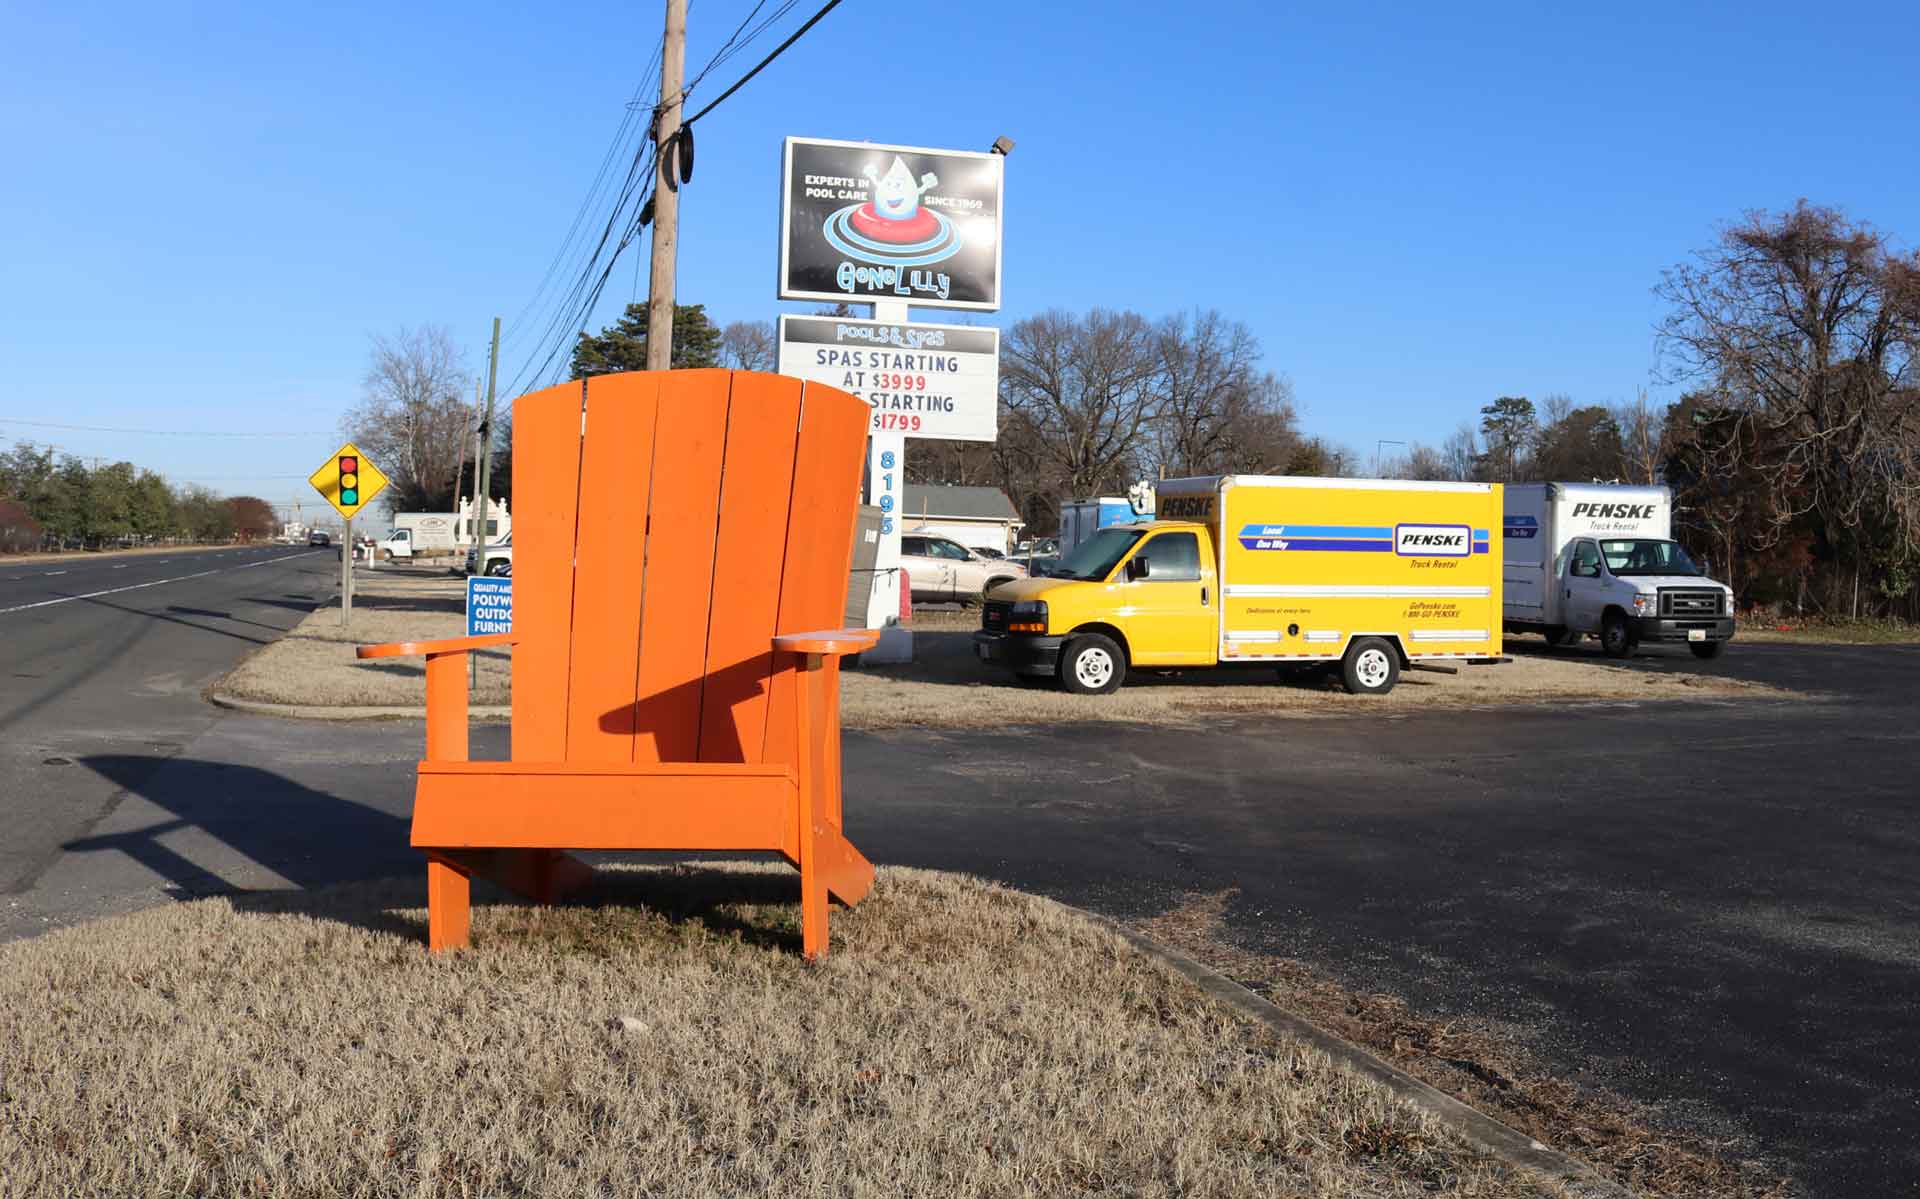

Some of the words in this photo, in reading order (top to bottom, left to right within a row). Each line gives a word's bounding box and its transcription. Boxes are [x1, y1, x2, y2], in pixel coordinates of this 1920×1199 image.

[804, 174, 855, 188] EXPERTS
[858, 178, 870, 188] IN
[805, 187, 835, 199] POOL
[838, 189, 868, 201] CARE
[924, 195, 956, 208] SINCE
[816, 349, 862, 367] SPAS
[870, 352, 958, 373] STARTING
[843, 371, 865, 388] AT
[872, 373, 926, 391] $3999
[870, 392, 954, 413] STARTING
[873, 413, 921, 431] $1799
[1160, 496, 1214, 517] PENSKE
[1572, 502, 1656, 519] PENSKE
[1590, 520, 1610, 530] Truck
[1613, 520, 1640, 530] Rental
[1402, 534, 1465, 547] PENSKE
[1410, 559, 1431, 569] Truck
[1432, 559, 1459, 569] Rental
[473, 583, 498, 593] QUALITY
